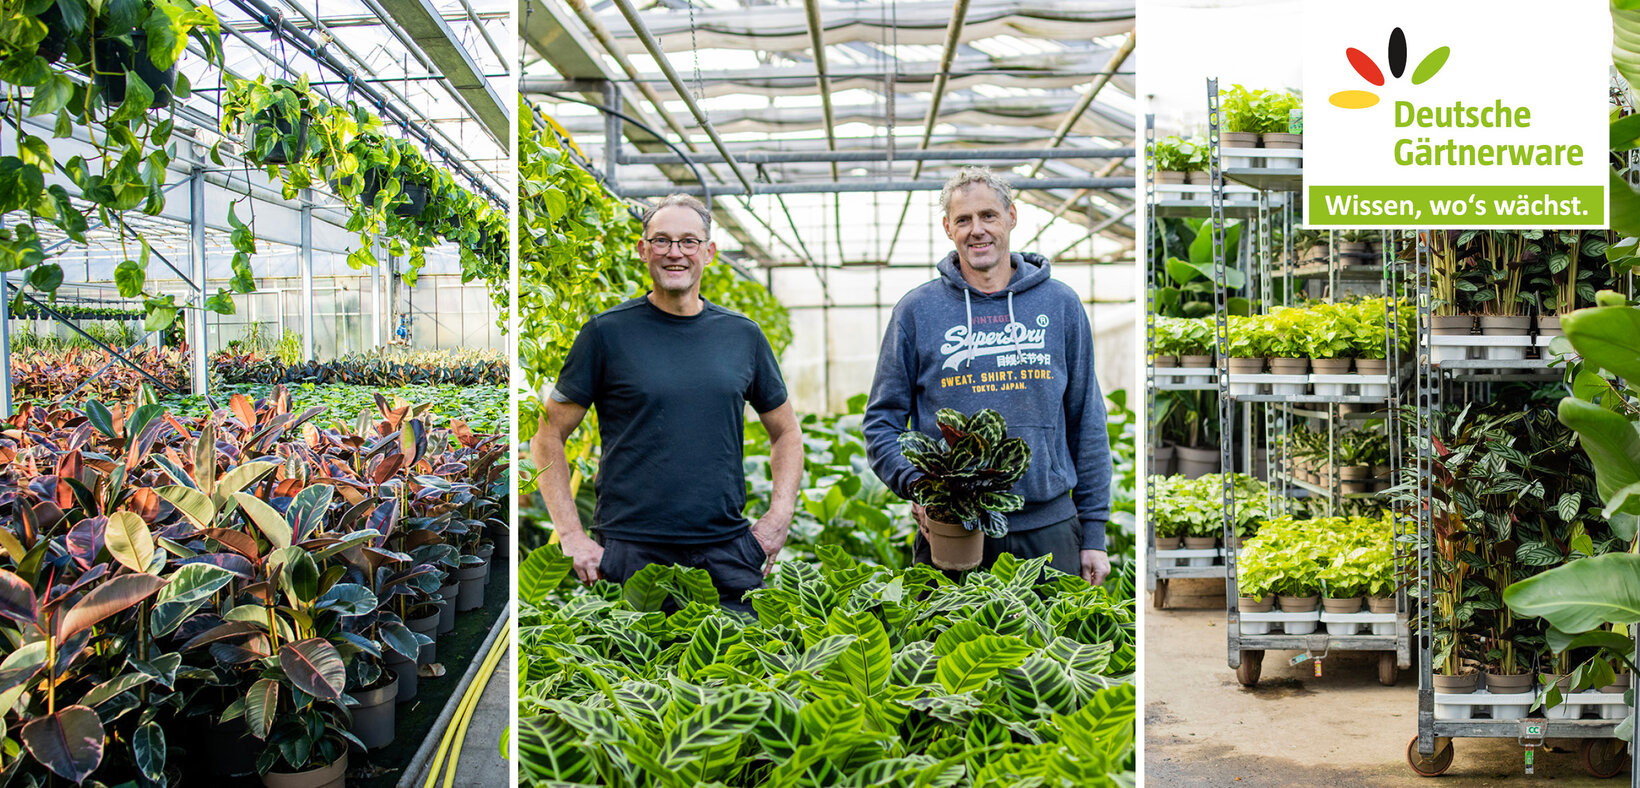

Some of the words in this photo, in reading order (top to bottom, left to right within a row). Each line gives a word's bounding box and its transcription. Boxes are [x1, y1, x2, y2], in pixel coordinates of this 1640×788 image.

[971, 314, 1011, 325] VINTAGE
[941, 374, 976, 388] SWEAT.
[981, 370, 1018, 382] SHIRT.
[1020, 369, 1055, 380] STORE.
[1001, 381, 1028, 391] JAPAN.
